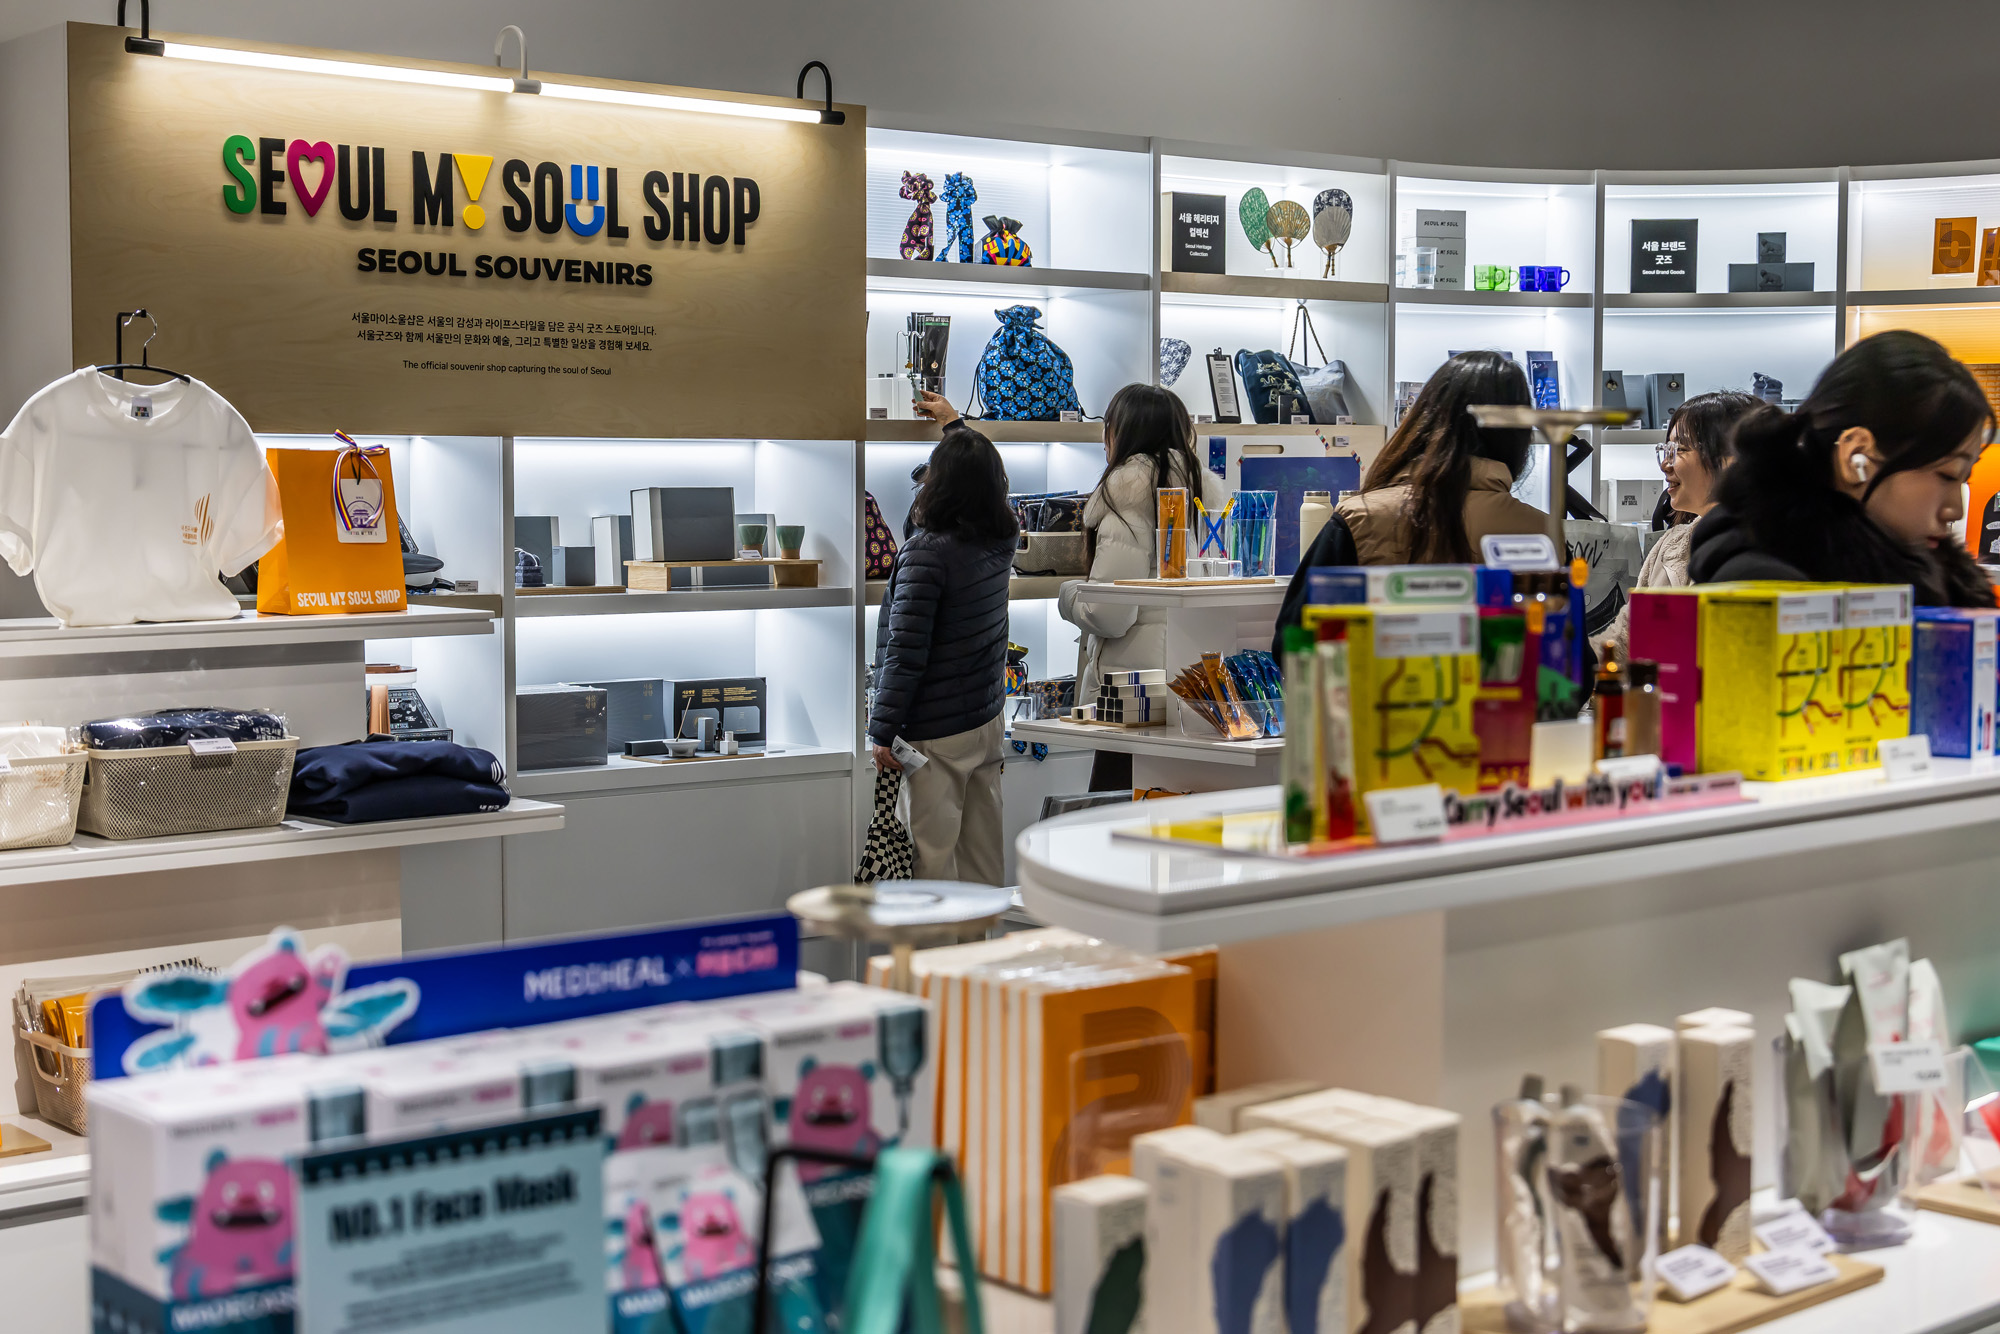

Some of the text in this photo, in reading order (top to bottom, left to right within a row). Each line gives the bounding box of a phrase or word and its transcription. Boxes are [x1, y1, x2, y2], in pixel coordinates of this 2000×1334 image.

[502, 158, 629, 239] SOUL
[642, 169, 761, 246] SHOP
[1642, 241, 1687, 252] 서울 브랜드
[357, 247, 654, 286] SEOUL SOUVENIRS
[1655, 254, 1673, 265] 굿즈
[351, 311, 657, 336] 서울마이소울샵은 서울의 감성과 라이프스타일을 담은 공식 굿즈 스토어입니다.
[357, 329, 652, 351] 서울굿즈와 함께 서울만의 문화와 예술, 그리고 특별한 일상을 경험해 보세요.
[403, 360, 612, 376] The official souvenir shop capturing the soul of Seoul
[297, 592, 330, 607] SEOUL
[348, 590, 374, 605] SOUL
[375, 589, 401, 604] SHOP
[1503, 778, 1564, 819] Seoul
[412, 1188, 486, 1230] Face
[494, 1168, 577, 1213] Mask
